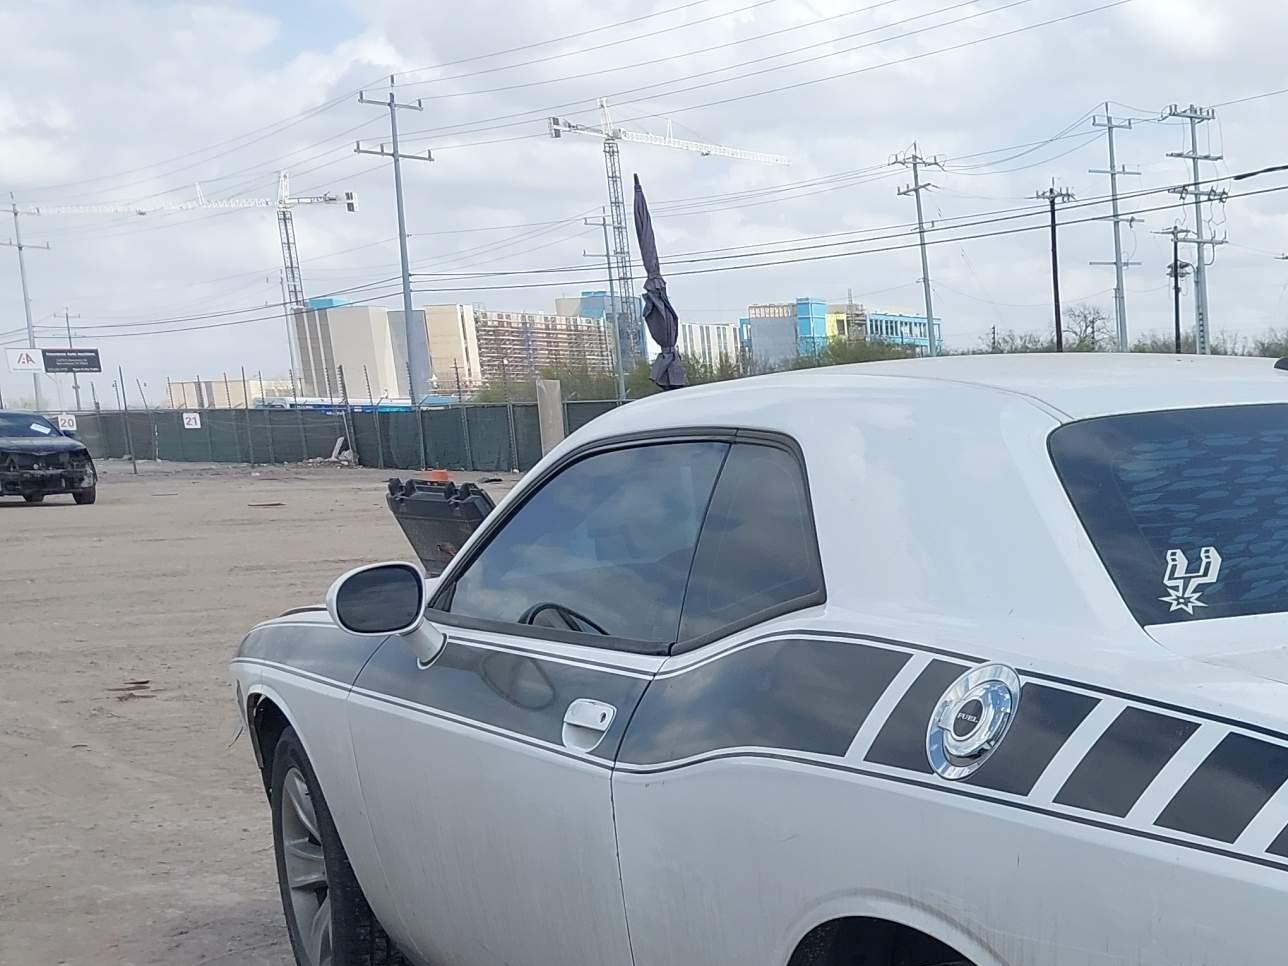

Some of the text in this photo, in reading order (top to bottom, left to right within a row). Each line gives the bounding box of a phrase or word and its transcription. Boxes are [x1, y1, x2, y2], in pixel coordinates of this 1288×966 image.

[60, 418, 75, 428] 20
[185, 416, 198, 426] 21
[957, 712, 979, 723] FUEL
